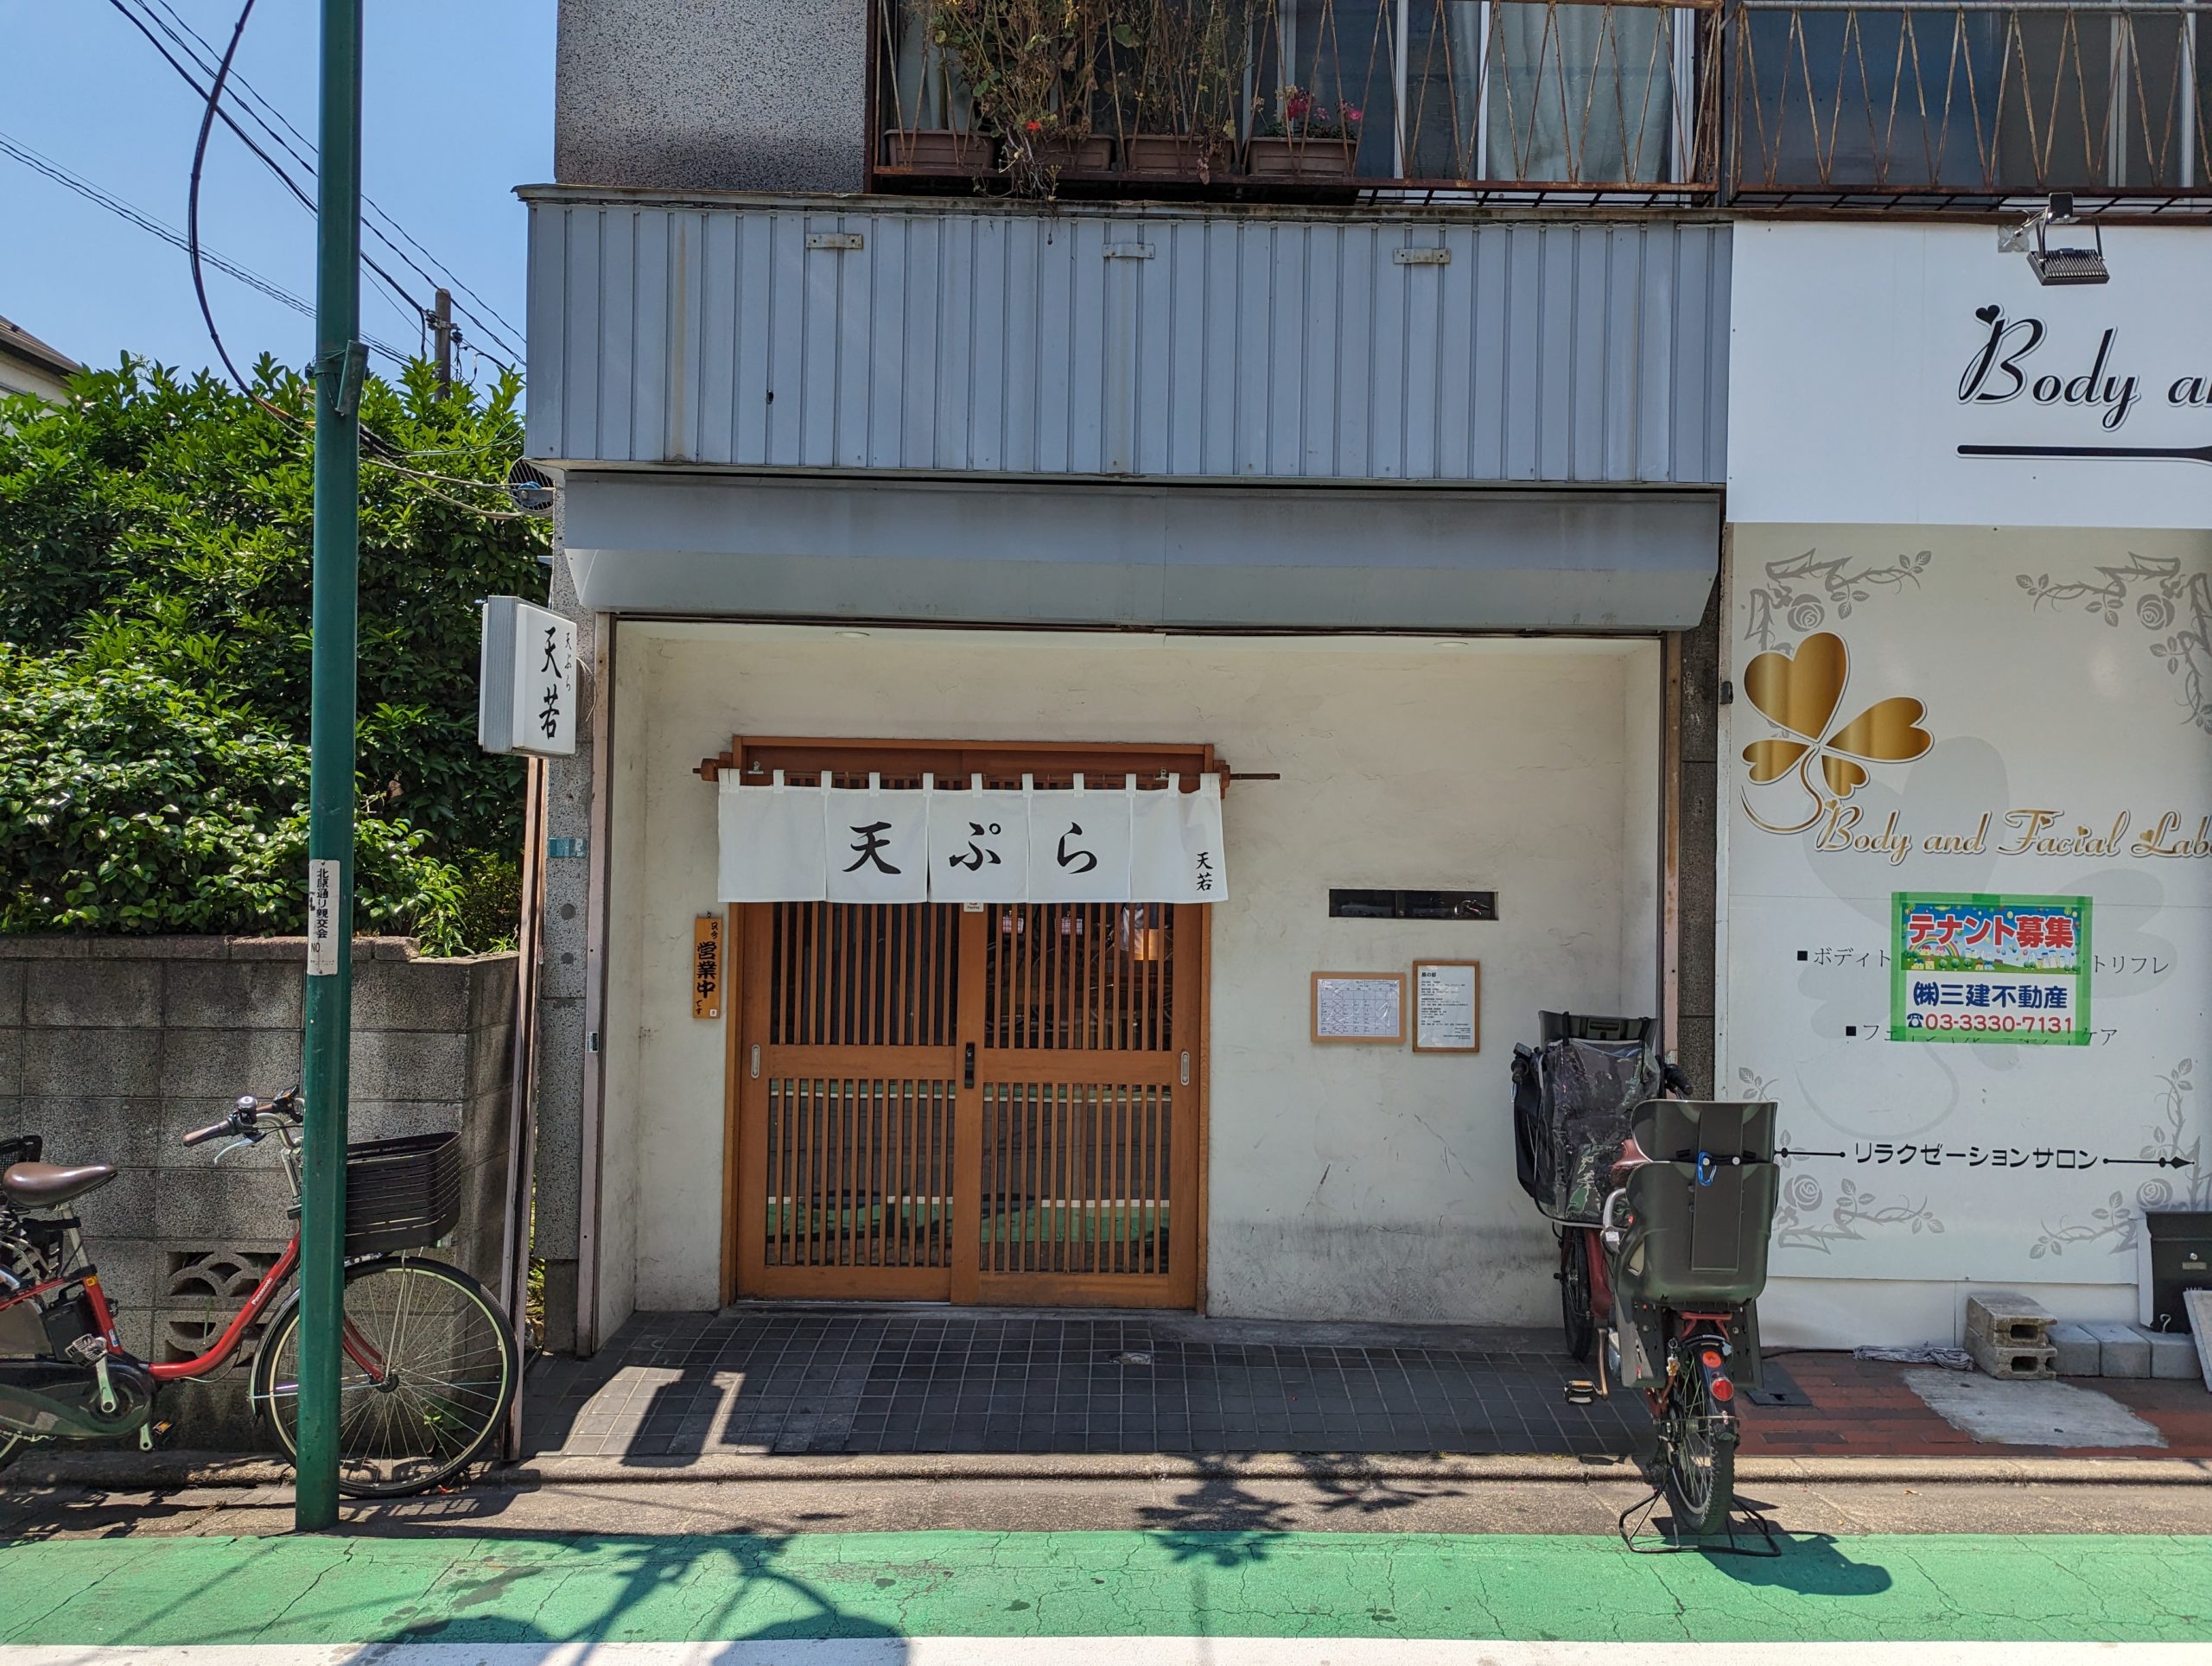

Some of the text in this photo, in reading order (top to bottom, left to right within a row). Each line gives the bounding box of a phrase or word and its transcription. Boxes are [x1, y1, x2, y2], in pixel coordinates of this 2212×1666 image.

[1958, 307, 2212, 429] Body a
[539, 626, 563, 741] 天若
[842, 821, 1097, 874] 天ぷら
[1816, 803, 2212, 864] Body and Facial Lab
[1196, 851, 1214, 891] 天若
[316, 868, 329, 938] 北原通り親交会
[1908, 913, 2075, 949] テナント募集
[697, 941, 717, 999] 営業中
[1814, 947, 2169, 974] ボディト トリフレ
[1925, 1013, 2072, 1034] 03-3330-7131
[1855, 1141, 2098, 1169] リラクゼーションサロン
[251, 1277, 273, 1306] Panasonic
